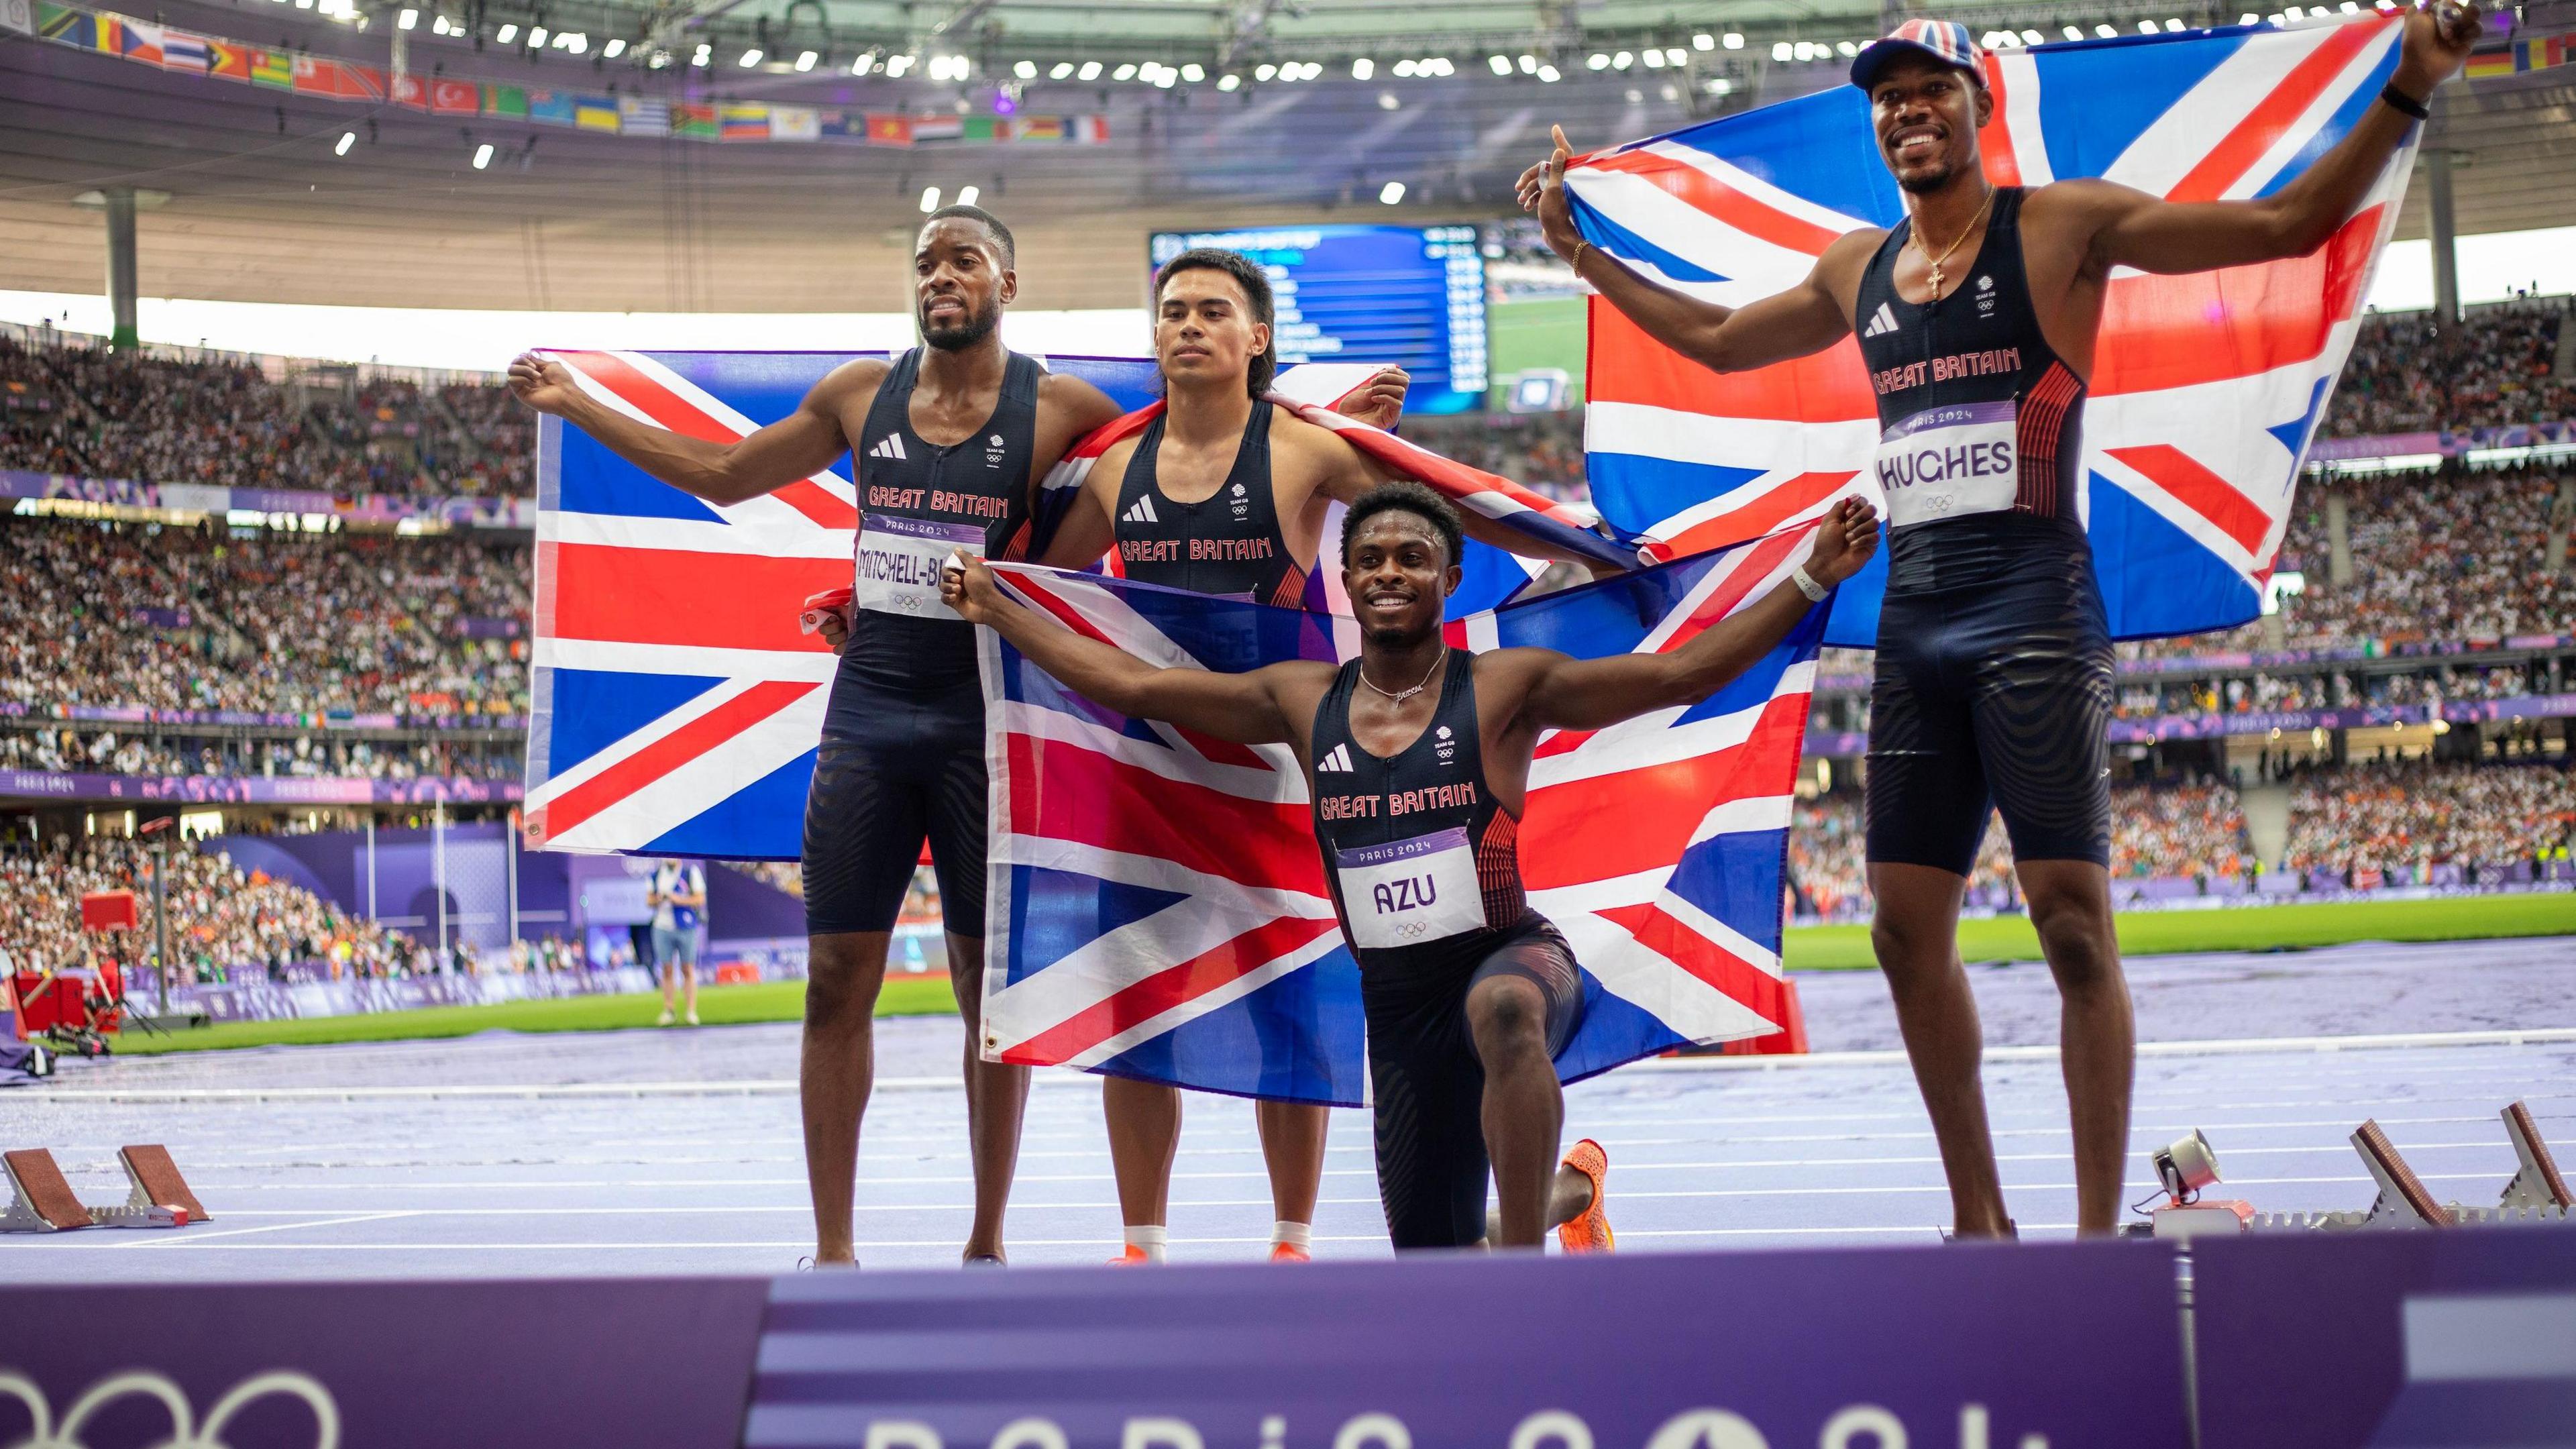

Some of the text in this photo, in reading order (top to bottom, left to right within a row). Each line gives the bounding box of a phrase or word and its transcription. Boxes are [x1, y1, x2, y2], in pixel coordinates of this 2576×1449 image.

[1873, 347, 2021, 395] GREAT BRITAIN
[1907, 410, 1973, 431] PARIS 2024
[1878, 441, 2013, 490] HUGHES
[869, 486, 1008, 519] GREAT BRITAIN
[885, 520, 950, 536] PARIS 2024
[1121, 537, 1273, 561] GREAT BRITAIN
[858, 548, 942, 588] MITCHELL-B
[1320, 782, 1477, 820] GREAT BRITAIN
[1359, 841, 1431, 862] PARIS 2024
[1373, 874, 1436, 914] AZU
